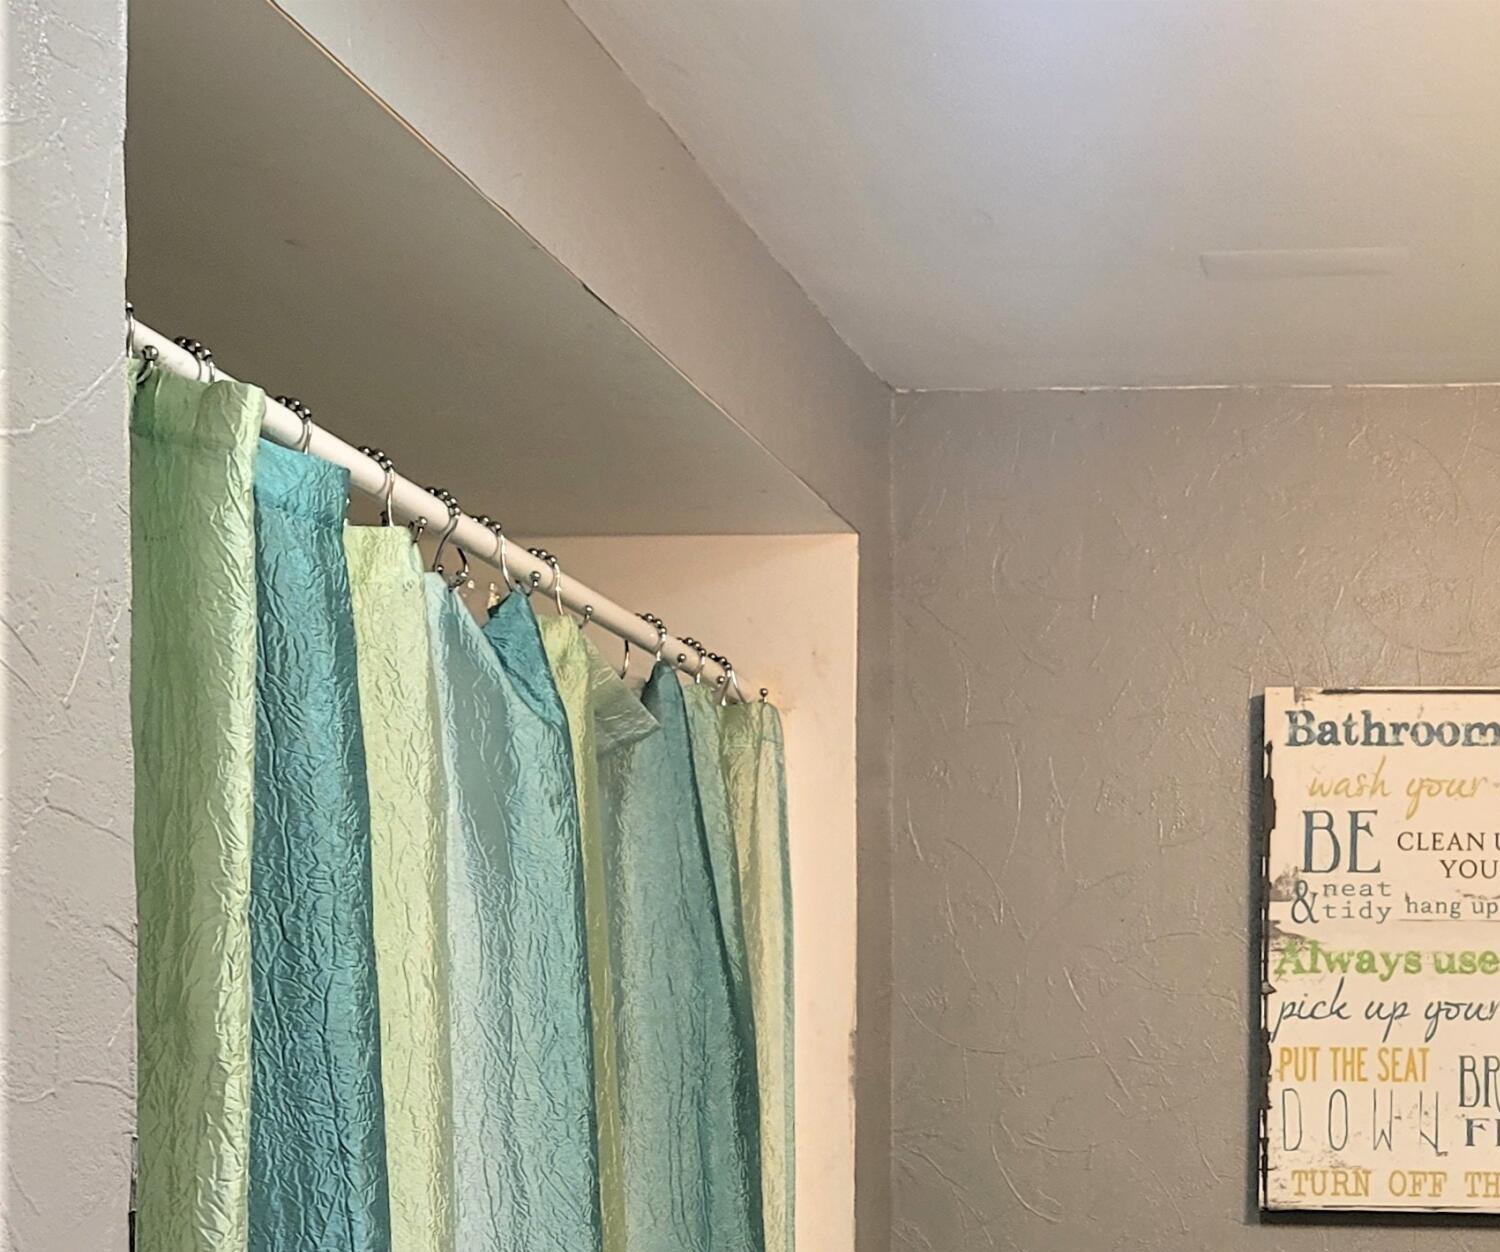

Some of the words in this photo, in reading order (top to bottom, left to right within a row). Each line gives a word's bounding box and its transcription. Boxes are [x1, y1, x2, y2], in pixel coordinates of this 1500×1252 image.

[1307, 756, 1391, 799] wash
[1405, 777, 1488, 820] your
[1301, 810, 1381, 874] BE
[1397, 832, 1485, 852] CLEAN
[1291, 880, 1320, 924] &
[1323, 880, 1392, 897] neat
[1405, 893, 1461, 918] hang
[1472, 900, 1499, 919] up
[1324, 902, 1392, 924] tidy
[1274, 939, 1422, 982] Always
[1432, 949, 1500, 974] use
[1271, 977, 1351, 1043] pick
[1364, 1000, 1411, 1042] up
[1278, 1047, 1321, 1082] PUT
[1329, 1047, 1368, 1082] THE
[1378, 1047, 1430, 1082] SEAT
[1292, 1170, 1371, 1197] TURN
[1389, 1171, 1447, 1197] OFF
